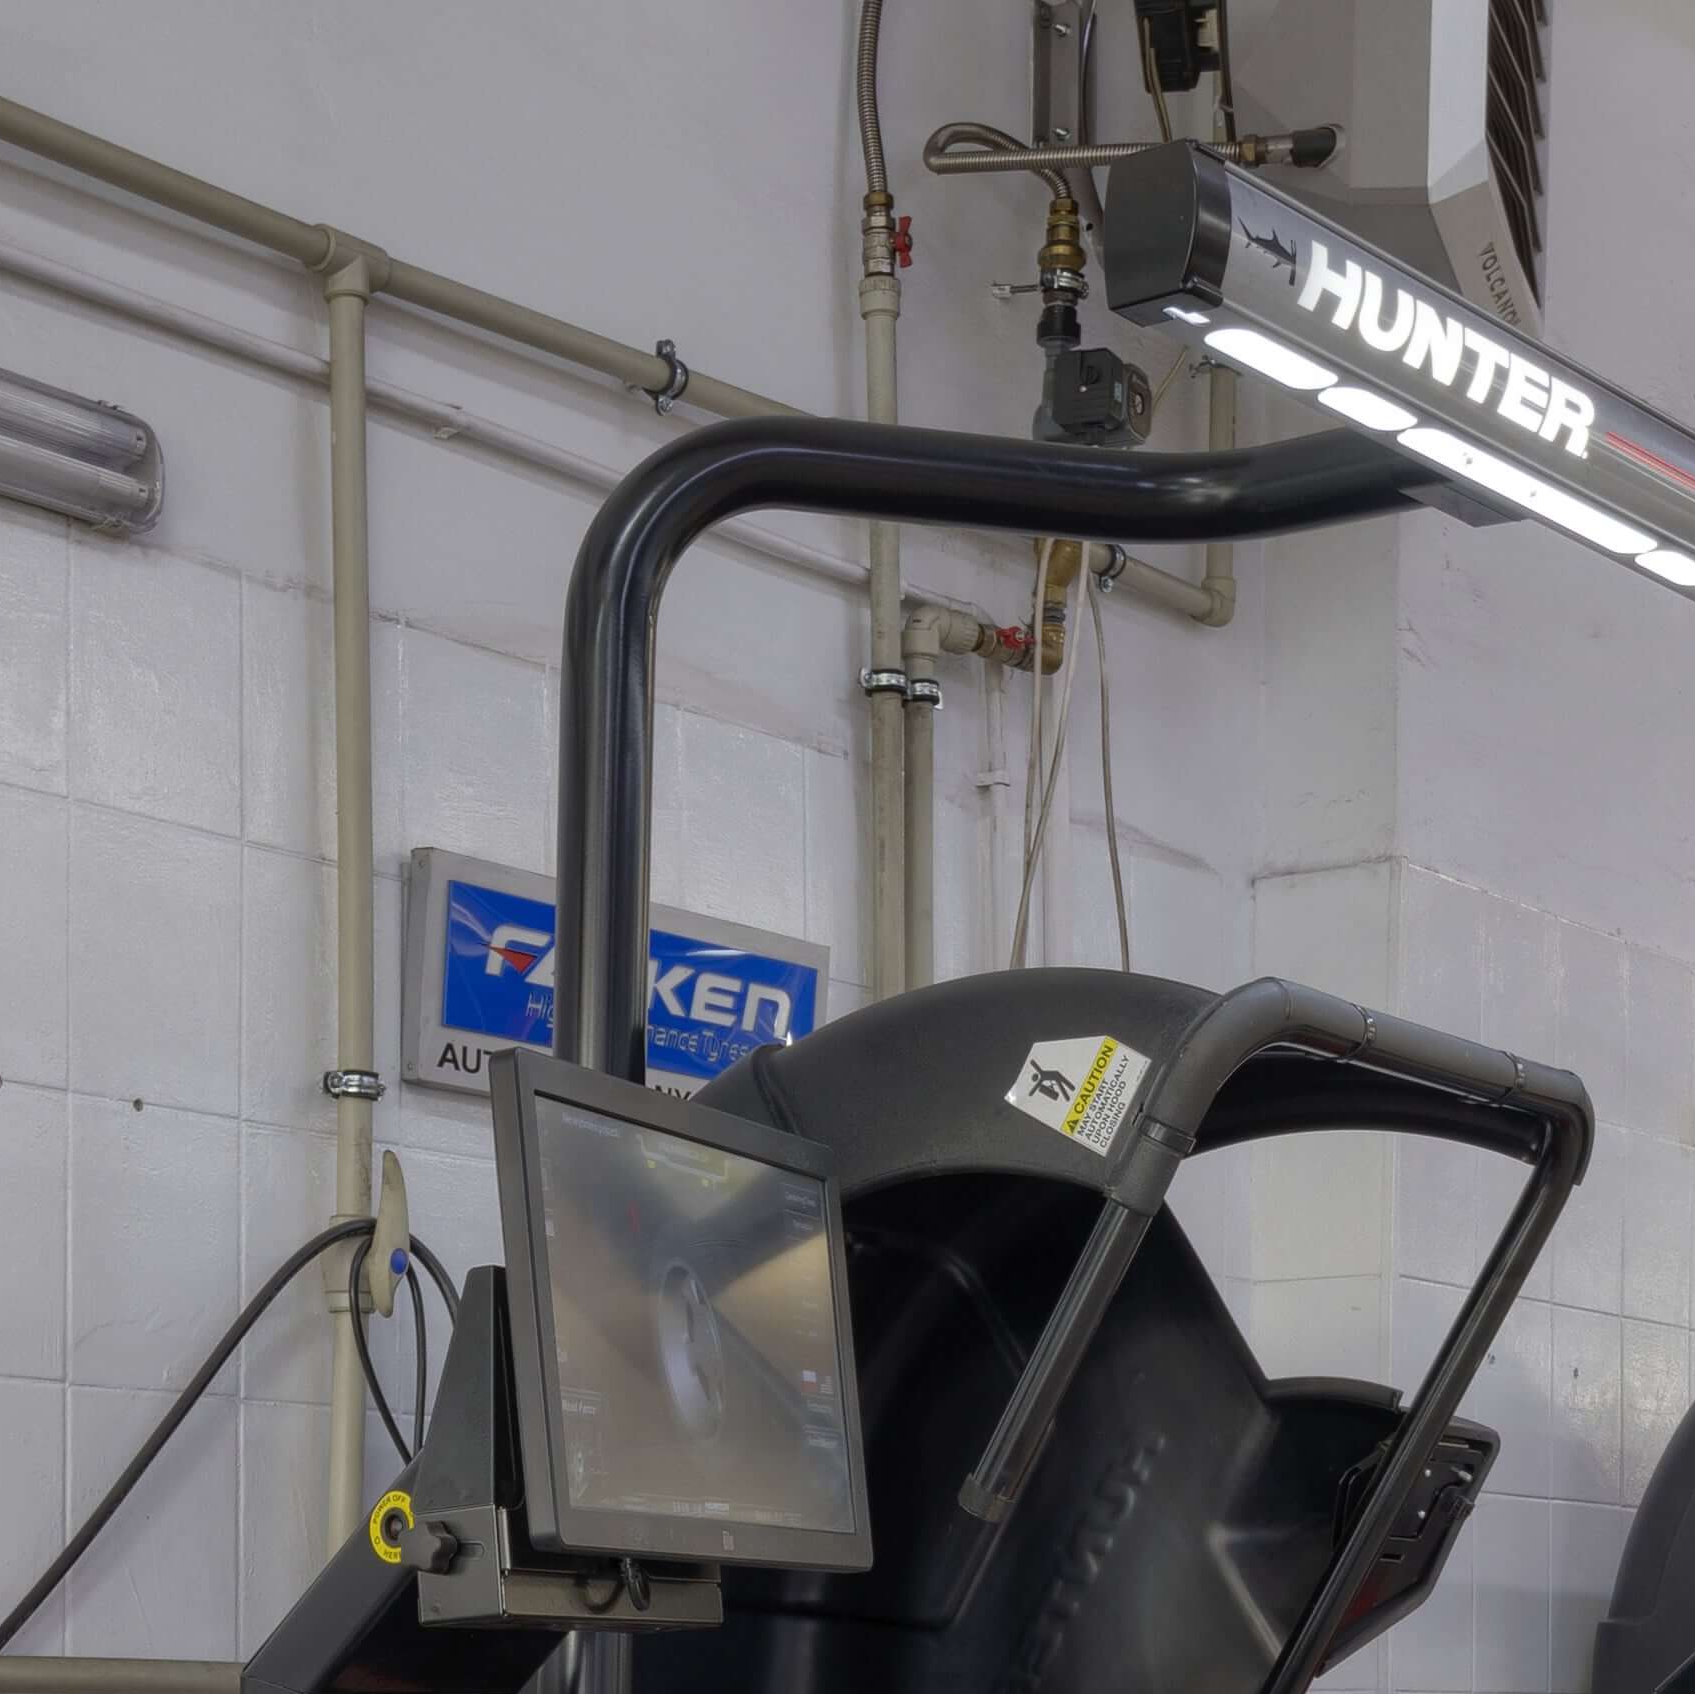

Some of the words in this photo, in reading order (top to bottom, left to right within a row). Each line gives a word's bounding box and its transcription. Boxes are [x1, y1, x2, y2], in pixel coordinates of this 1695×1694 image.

[1297, 239, 1596, 458] HUNTER
[1073, 1044, 1114, 1115] CAUTION
[1085, 1055, 1130, 1141] AUTOMATICALLY
[1092, 1114, 1111, 1144] UPON
[1108, 1081, 1126, 1113] HOOD
[1077, 1113, 1092, 1137] MAY
[1099, 1102, 1126, 1148] CLOSING
